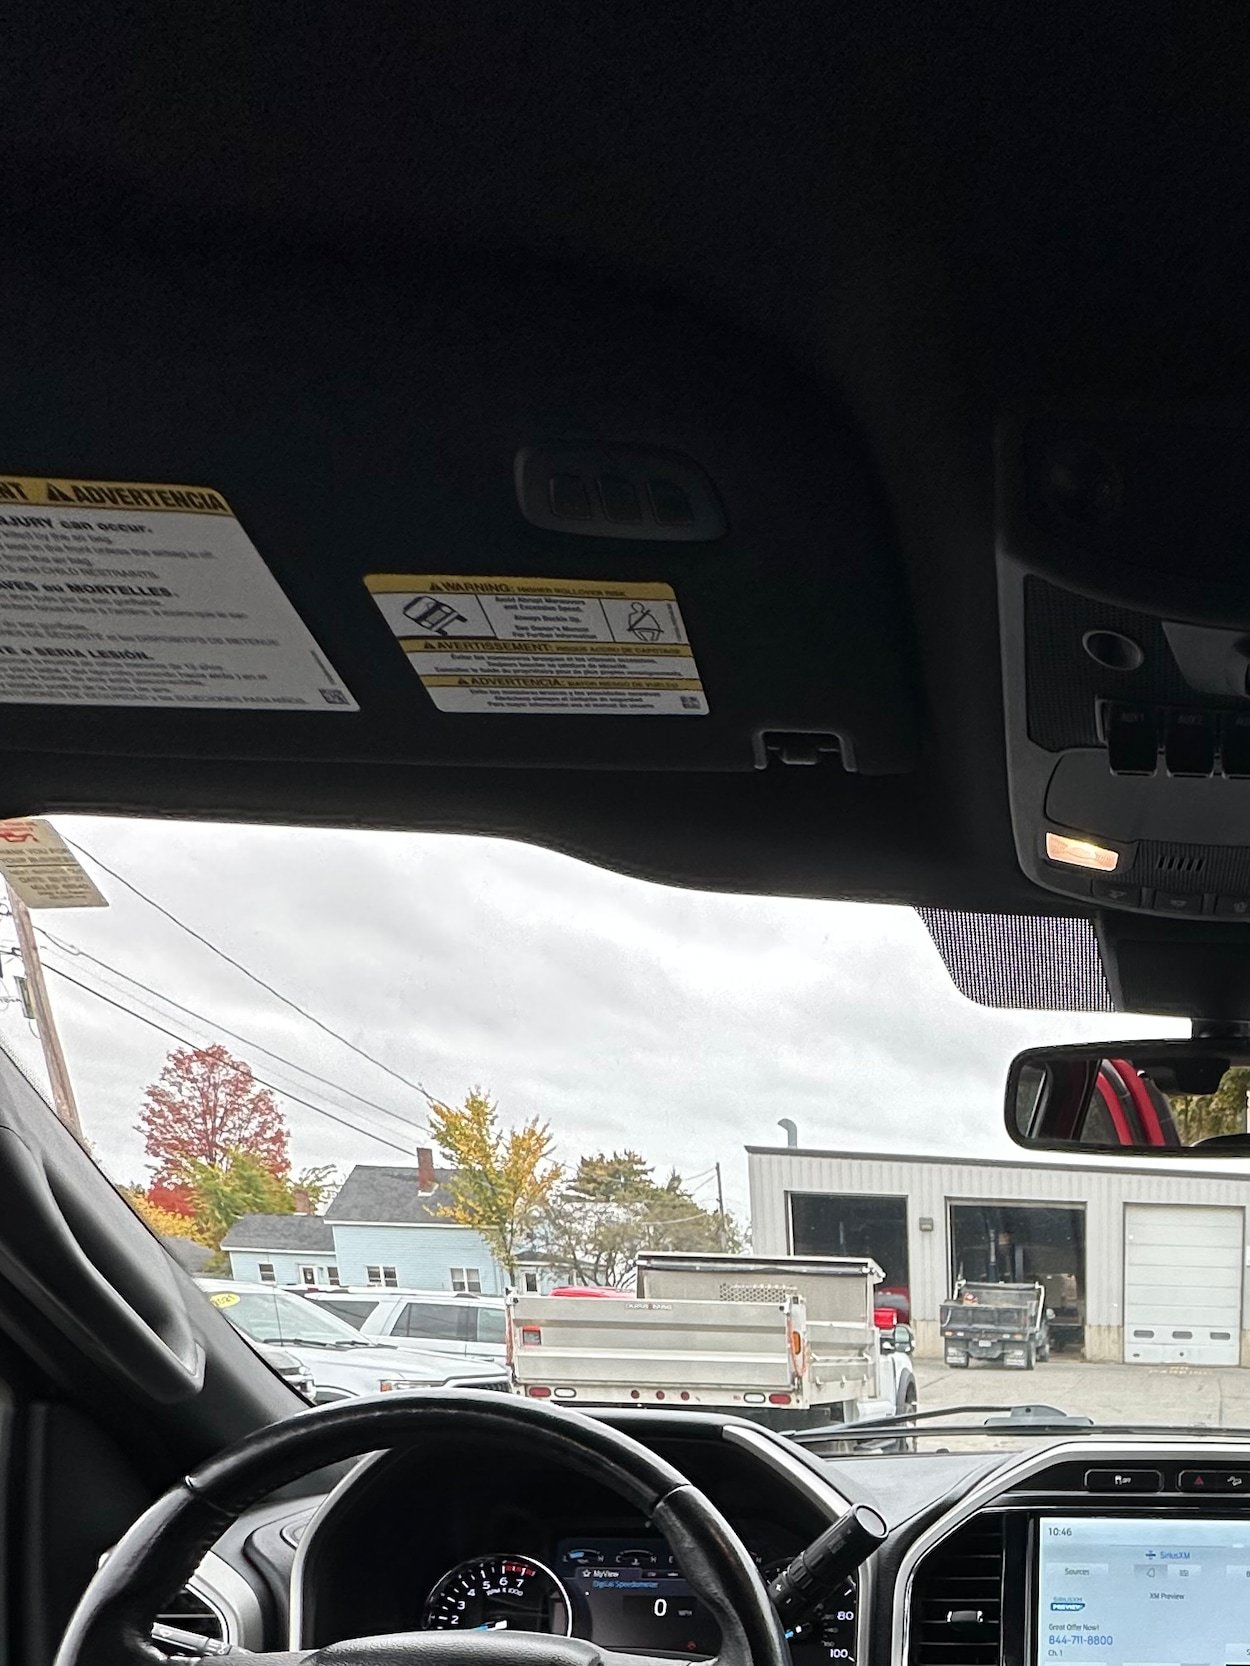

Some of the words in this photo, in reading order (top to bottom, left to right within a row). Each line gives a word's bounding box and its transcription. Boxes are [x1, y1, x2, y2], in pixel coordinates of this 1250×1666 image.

[72, 485, 226, 511] ADVERTENCIA
[60, 520, 95, 530] can
[96, 522, 154, 533] occur.
[66, 583, 180, 597] MORTELLES.
[440, 582, 514, 594] WARNING:
[437, 642, 555, 652] AVERTISSEMENT:
[34, 646, 87, 658] SERIA
[88, 648, 156, 660] LESIÓN.
[470, 677, 567, 687] ADVERTENCIA:
[1048, 1527, 1073, 1537] 10:46
[1159, 1551, 1190, 1559] SiriusXM
[593, 1569, 619, 1578] MyView
[1064, 1568, 1090, 1577] Sources
[482, 1581, 491, 1590] 5
[499, 1577, 508, 1586] 6
[516, 1579, 525, 1588] 7
[466, 1588, 476, 1597] 4
[1149, 1592, 1159, 1600] XM
[1161, 1592, 1184, 1602] Preview
[456, 1601, 465, 1610] 3
[653, 1598, 668, 1617] 0
[450, 1615, 459, 1625] 2
[837, 1611, 854, 1621] 80
[1049, 1624, 1065, 1632] Great
[1067, 1624, 1081, 1632] Offer
[1049, 1635, 1114, 1646] 844-711-8800
[830, 1649, 848, 1659] 100
[1049, 1649, 1059, 1657] Ch.
